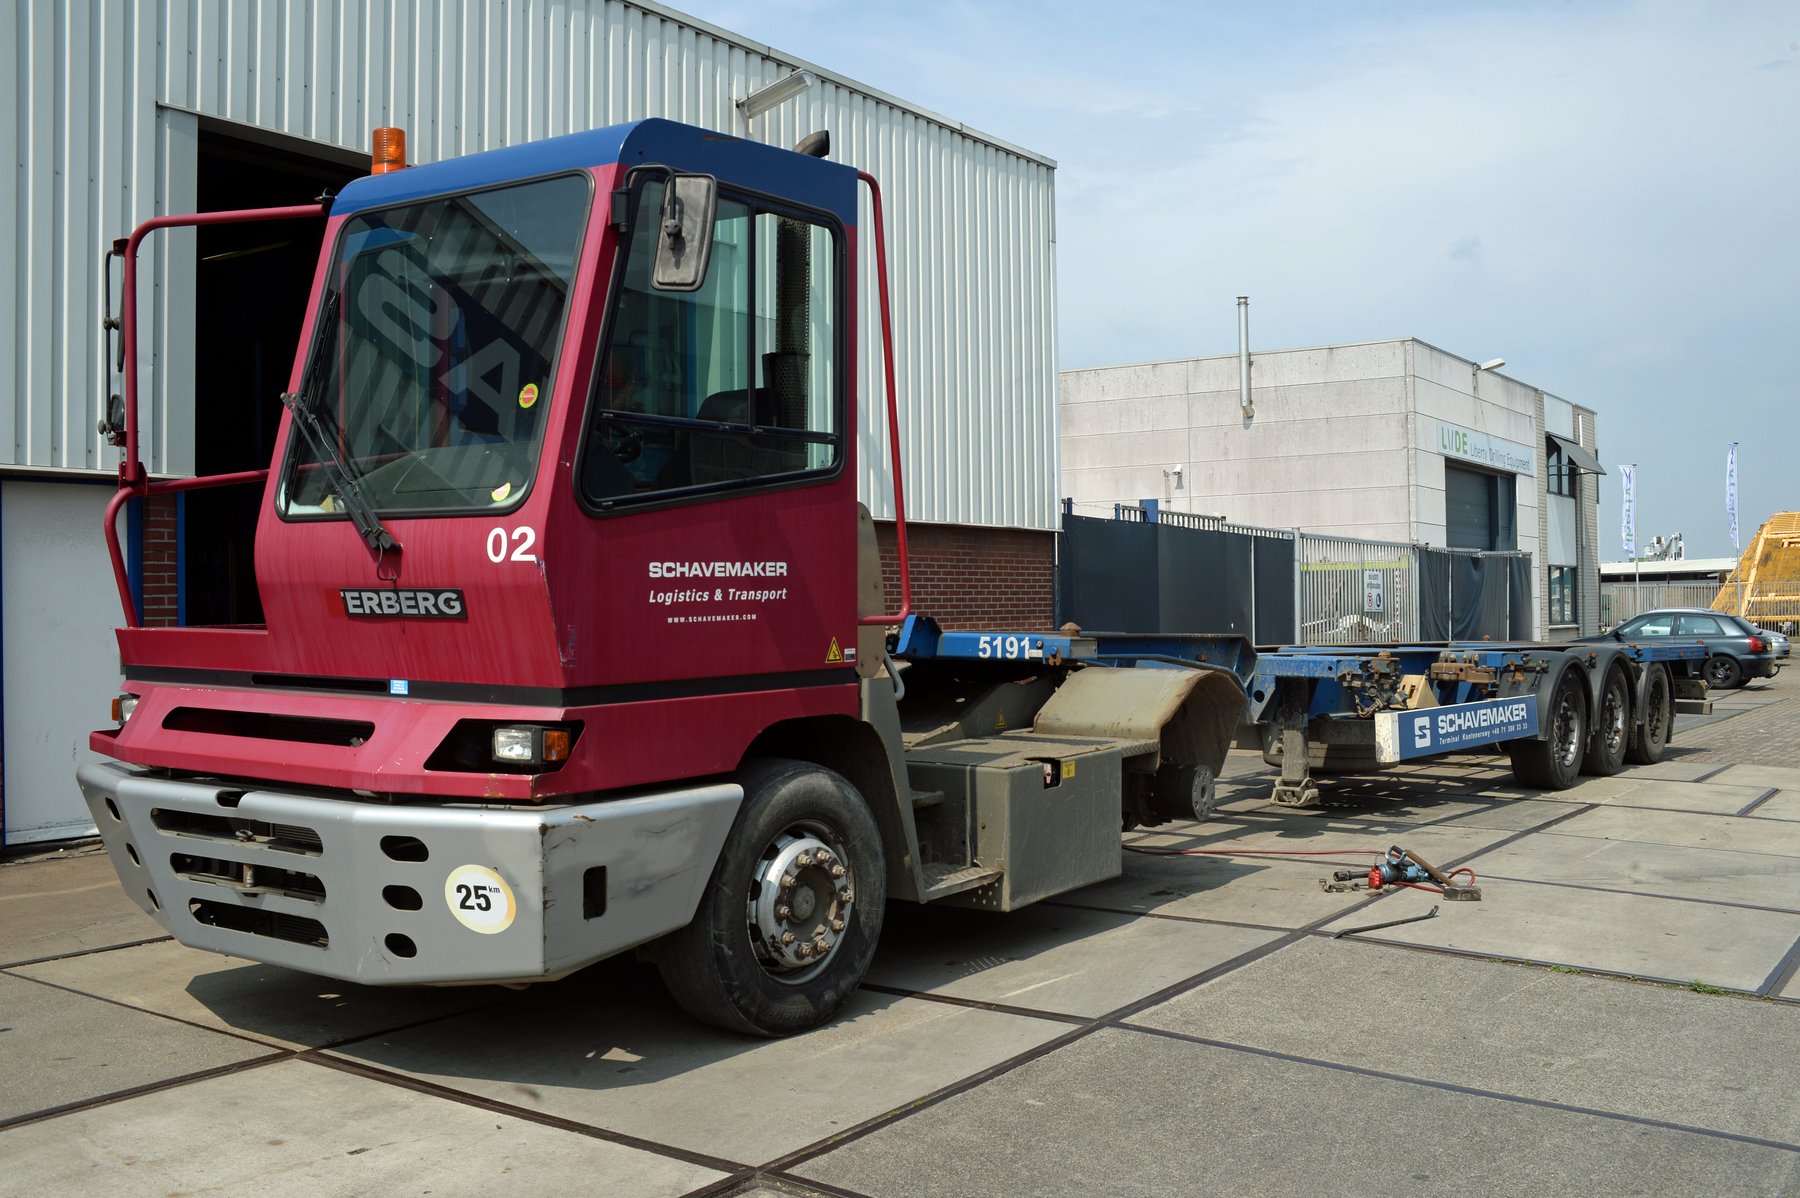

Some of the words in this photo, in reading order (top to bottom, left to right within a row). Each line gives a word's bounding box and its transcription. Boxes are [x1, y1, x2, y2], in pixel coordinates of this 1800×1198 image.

[486, 526, 536, 563] 02
[649, 562, 787, 578] SCHAVEMAKER
[340, 591, 461, 615] ERBERG
[649, 589, 709, 605] Logistics
[714, 588, 723, 601] &
[728, 588, 787, 602] Transport
[978, 636, 1030, 660] 5191
[1438, 703, 1527, 734] SCHAVEMAKER
[1440, 735, 1460, 745] Terminal
[456, 884, 492, 912] 25
